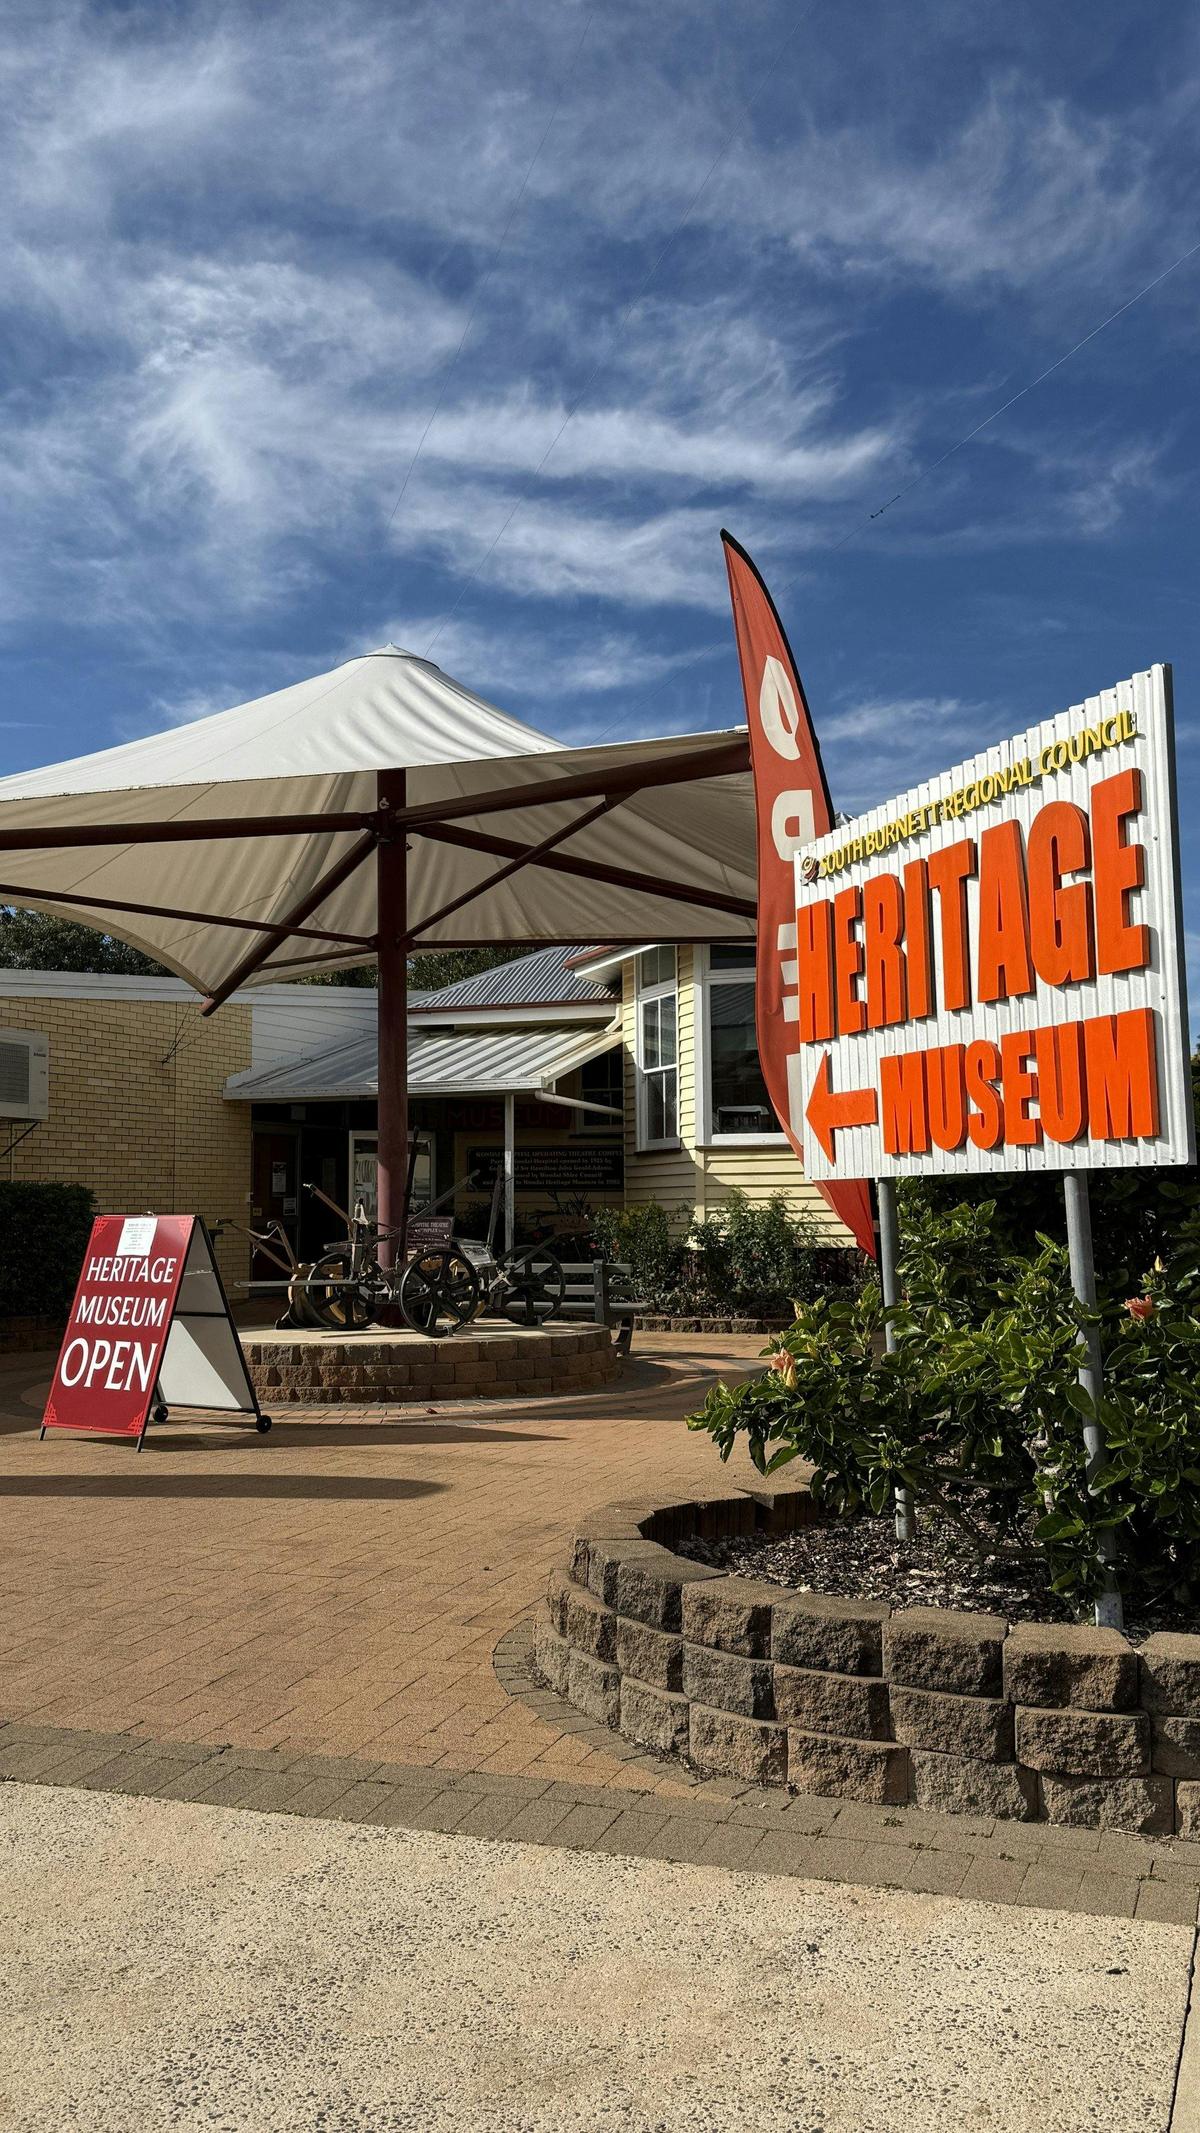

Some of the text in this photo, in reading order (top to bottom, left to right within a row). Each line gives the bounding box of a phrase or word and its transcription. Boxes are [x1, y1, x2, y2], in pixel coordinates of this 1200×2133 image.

[819, 710, 1138, 878] SOUTH BURNETT REGIONAL COUNCIL
[797, 768, 1150, 1044] HERITAGE
[880, 1007, 1159, 1154] MUSEUM
[75, 1296, 167, 1327] MUSEUM
[86, 1257, 177, 1284] HERITAGE
[60, 1337, 158, 1393] OPEN
